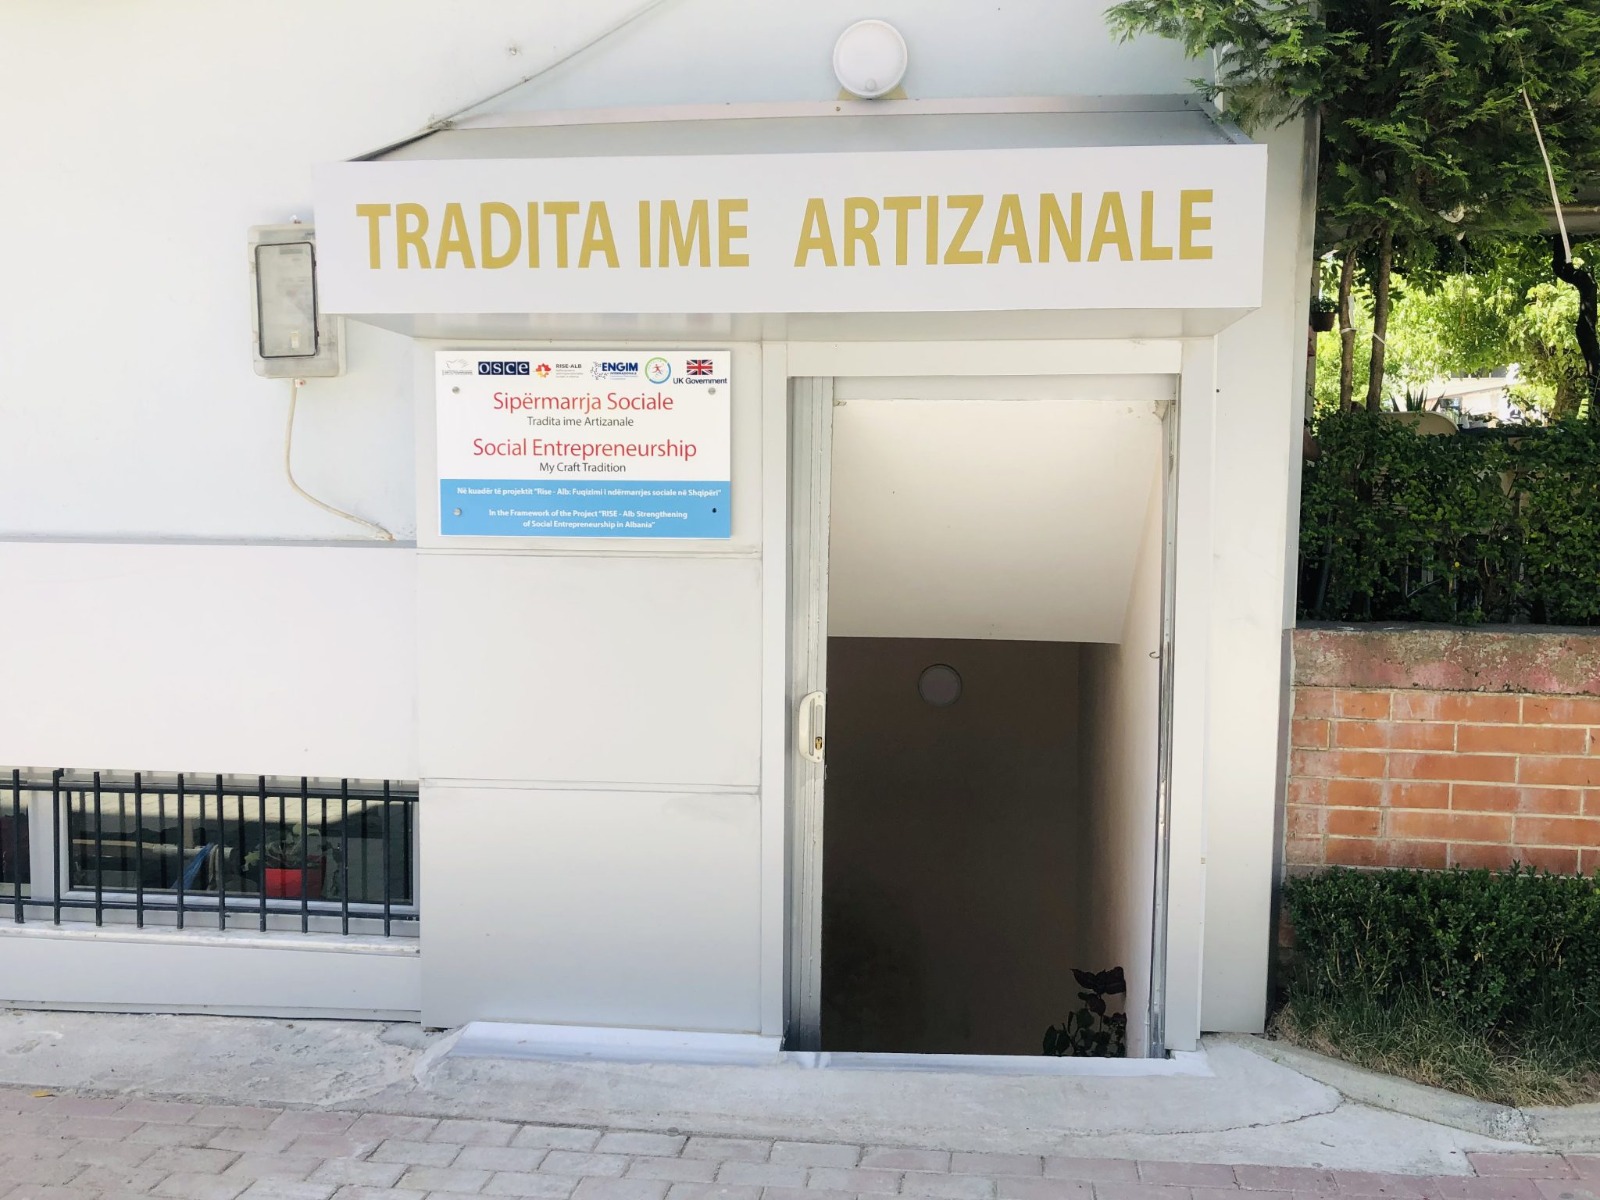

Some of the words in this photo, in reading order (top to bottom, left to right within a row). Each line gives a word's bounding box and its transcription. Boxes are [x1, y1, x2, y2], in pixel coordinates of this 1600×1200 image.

[356, 201, 620, 269] TRADITA
[638, 199, 749, 268] IME
[794, 189, 1213, 267] ARTIZANALE
[601, 362, 638, 371] ENGIM
[493, 392, 602, 414] Sipërmarrja
[606, 392, 674, 410] Sociale
[527, 416, 561, 427] Tradita
[563, 416, 582, 427] ime
[584, 416, 634, 427] Artizanale
[473, 438, 527, 456] Social
[532, 438, 697, 461] Entrepreneurship
[539, 462, 555, 473] My
[556, 462, 581, 472] Craft
[582, 463, 626, 472] Tradition
[468, 487, 493, 495] kuadër
[494, 487, 502, 495] të
[502, 487, 533, 496] projektit
[572, 488, 603, 497] Fuqizimi
[607, 488, 651, 497] ndërmarrjes
[510, 509, 550, 517] Framework
[551, 509, 559, 517] of
[573, 510, 598, 518] Project
[636, 510, 688, 519] Strengthening
[553, 520, 616, 529] Entrepreneurship
